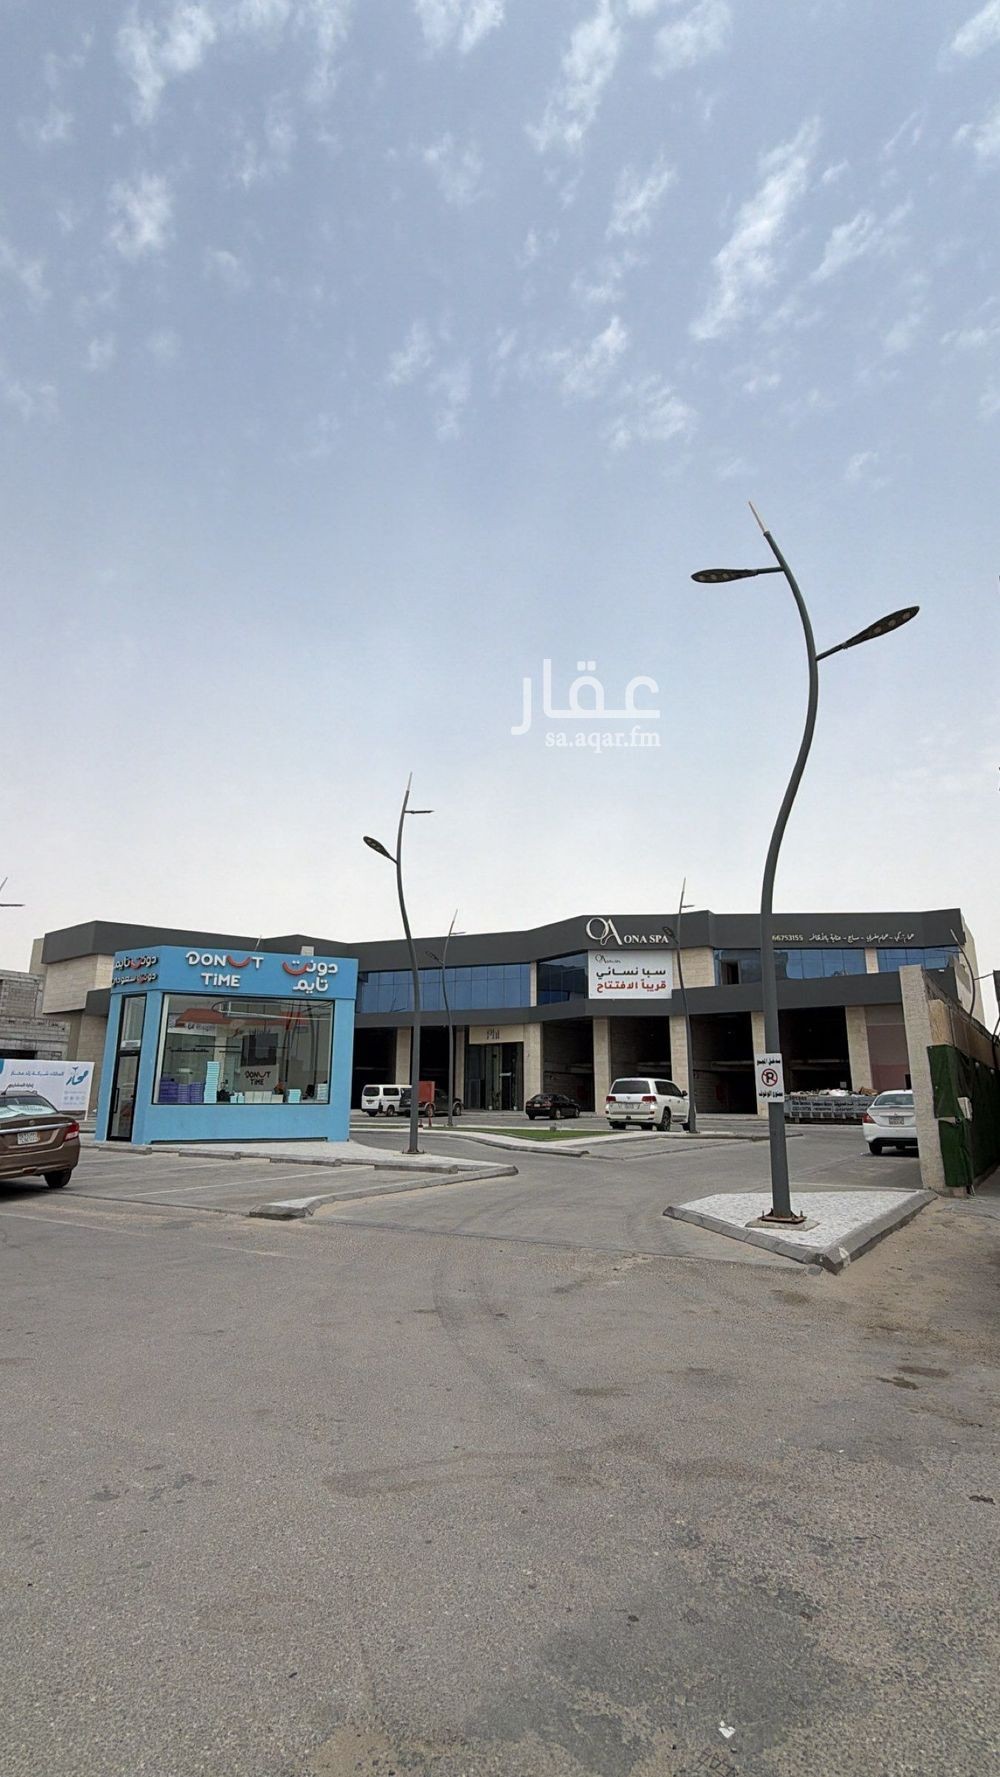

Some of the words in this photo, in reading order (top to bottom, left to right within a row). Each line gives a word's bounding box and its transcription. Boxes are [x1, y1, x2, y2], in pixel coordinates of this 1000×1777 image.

[623, 934, 648, 944] ONA
[649, 934, 669, 944] SPA
[185, 951, 264, 969] DONUT
[282, 959, 338, 977] دونت
[642, 967, 666, 978] سبا
[293, 976, 329, 994] تايم
[597, 980, 638, 993] الافتتاح
